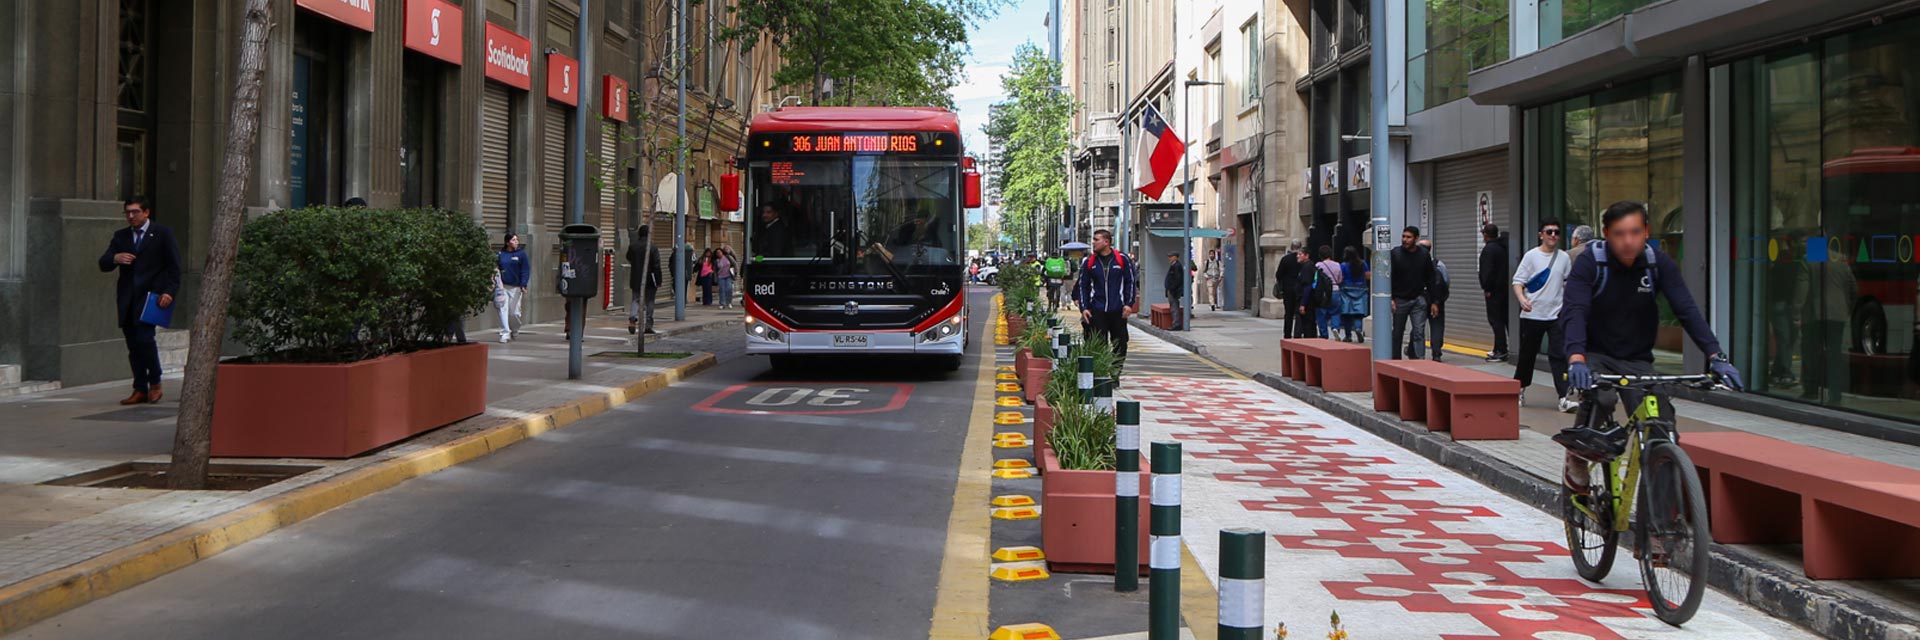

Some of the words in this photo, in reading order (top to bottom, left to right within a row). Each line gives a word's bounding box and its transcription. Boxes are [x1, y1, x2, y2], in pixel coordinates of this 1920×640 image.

[488, 39, 529, 77] Scotiabank
[792, 135, 812, 152] 306
[815, 135, 840, 152] JUAN
[843, 135, 888, 152] ANTONIO
[890, 135, 917, 152] RIOS
[755, 281, 775, 296] Red
[810, 281, 894, 290] ZHONGTONG
